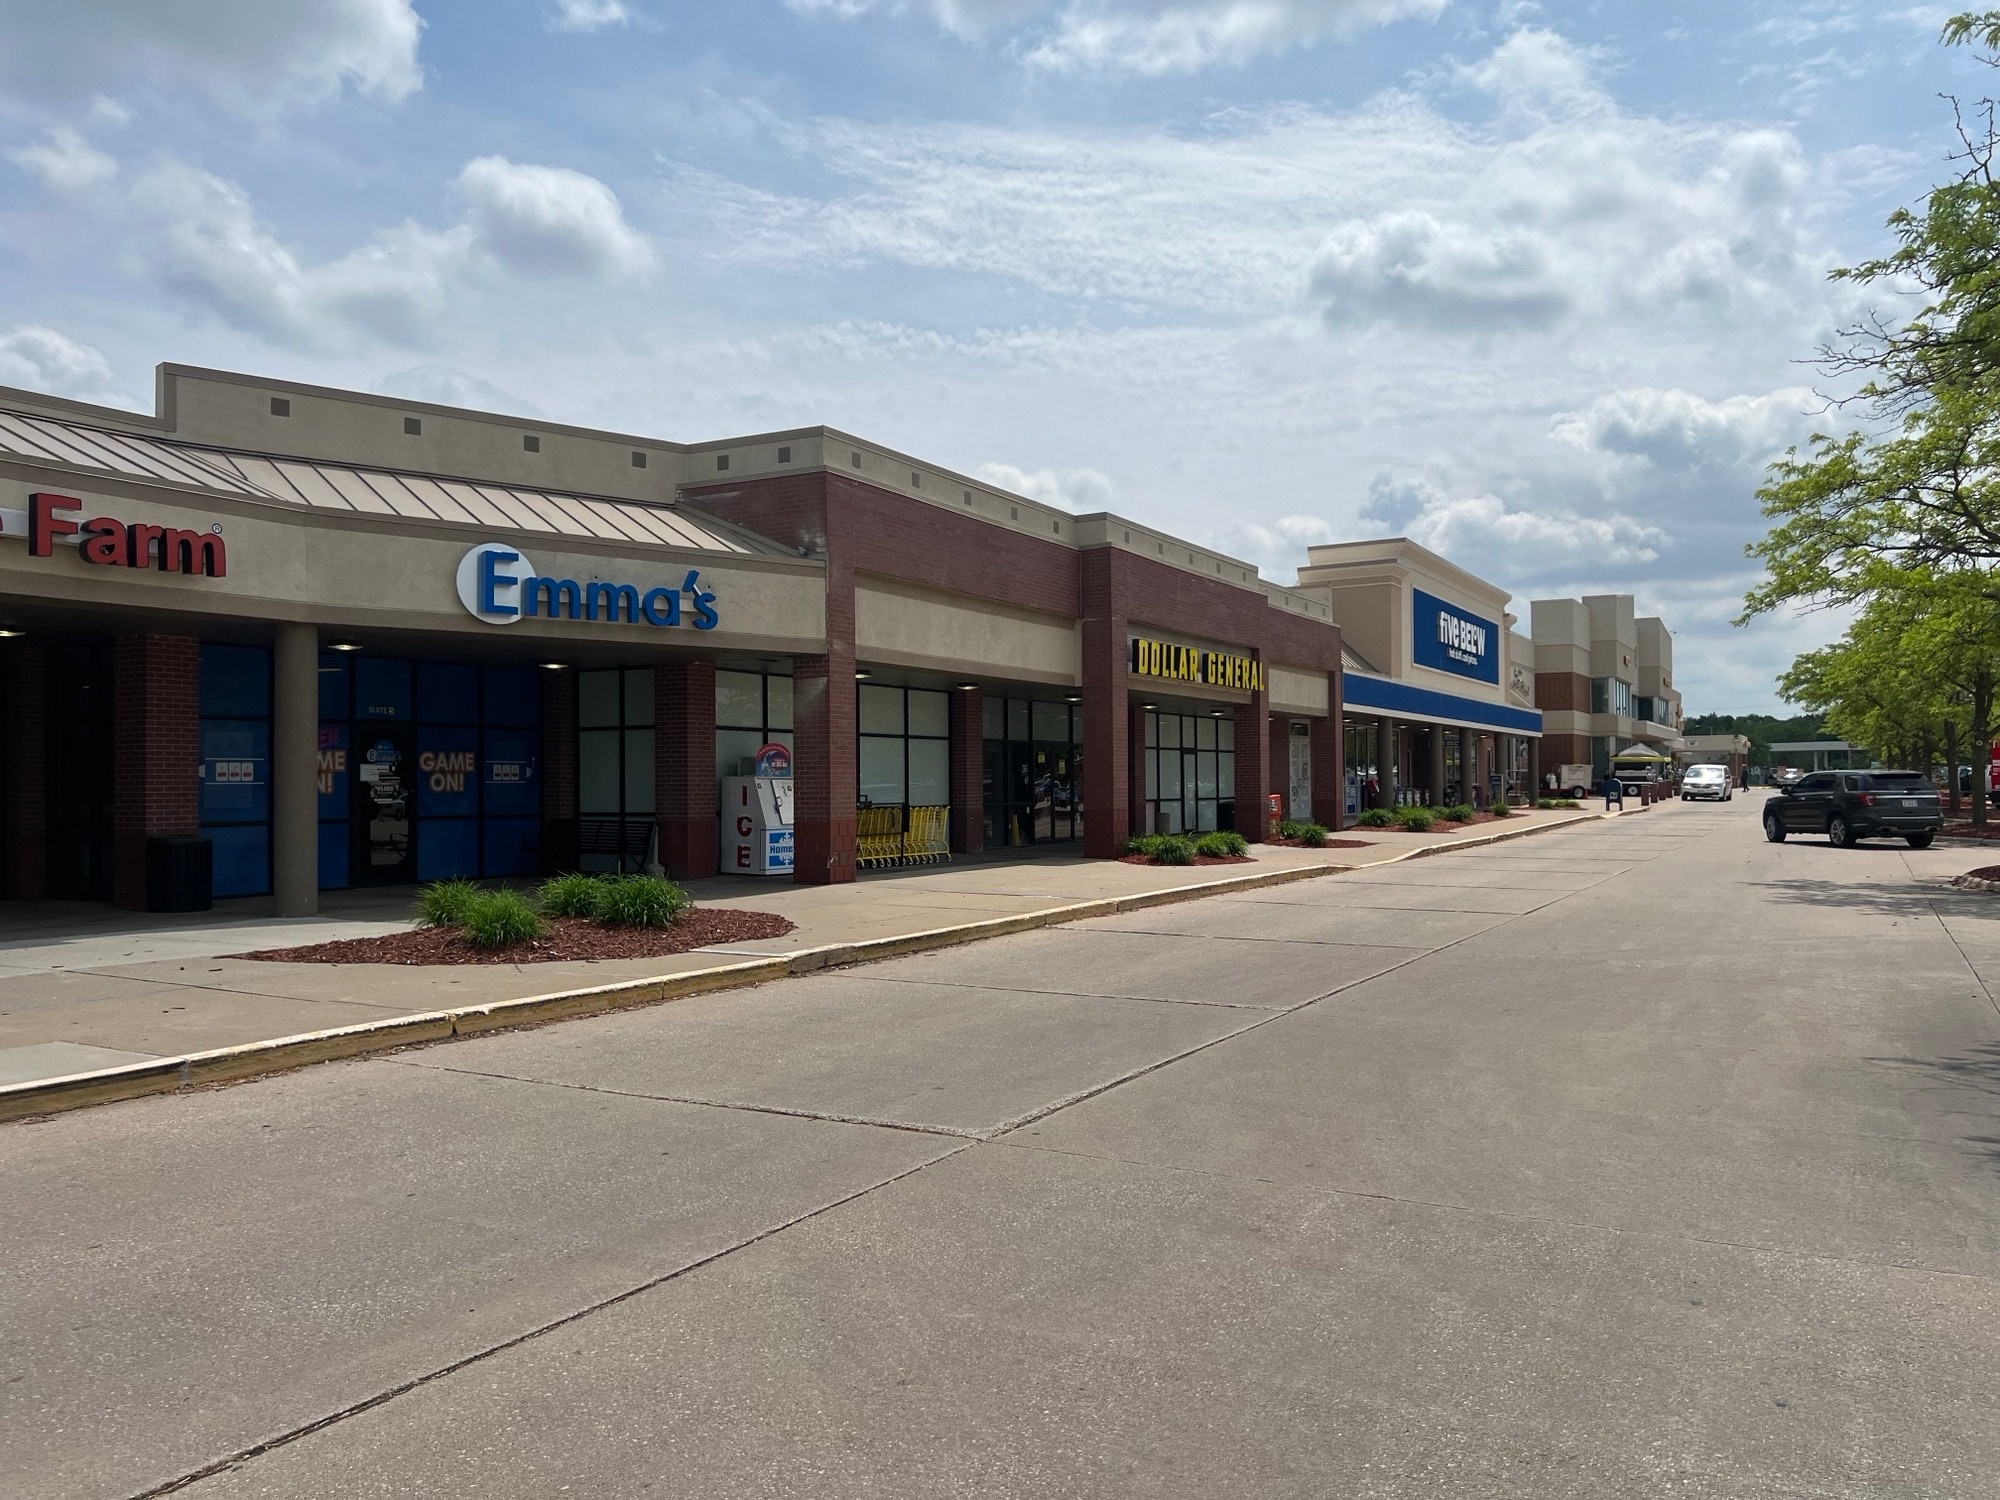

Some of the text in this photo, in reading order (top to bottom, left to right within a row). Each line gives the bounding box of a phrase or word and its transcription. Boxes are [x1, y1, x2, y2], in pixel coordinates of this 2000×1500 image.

[29, 492, 227, 578] Farm
[477, 549, 719, 631] Emma's
[1132, 638, 1265, 692] DOLLAR GENERAL
[368, 705, 388, 714] SUITE
[319, 727, 339, 748] EN
[317, 750, 346, 771] ME
[418, 750, 475, 771] GAME
[317, 773, 333, 792] N!
[430, 772, 465, 792] ON!
[737, 784, 752, 868] ICE
[770, 845, 793, 854] Home
